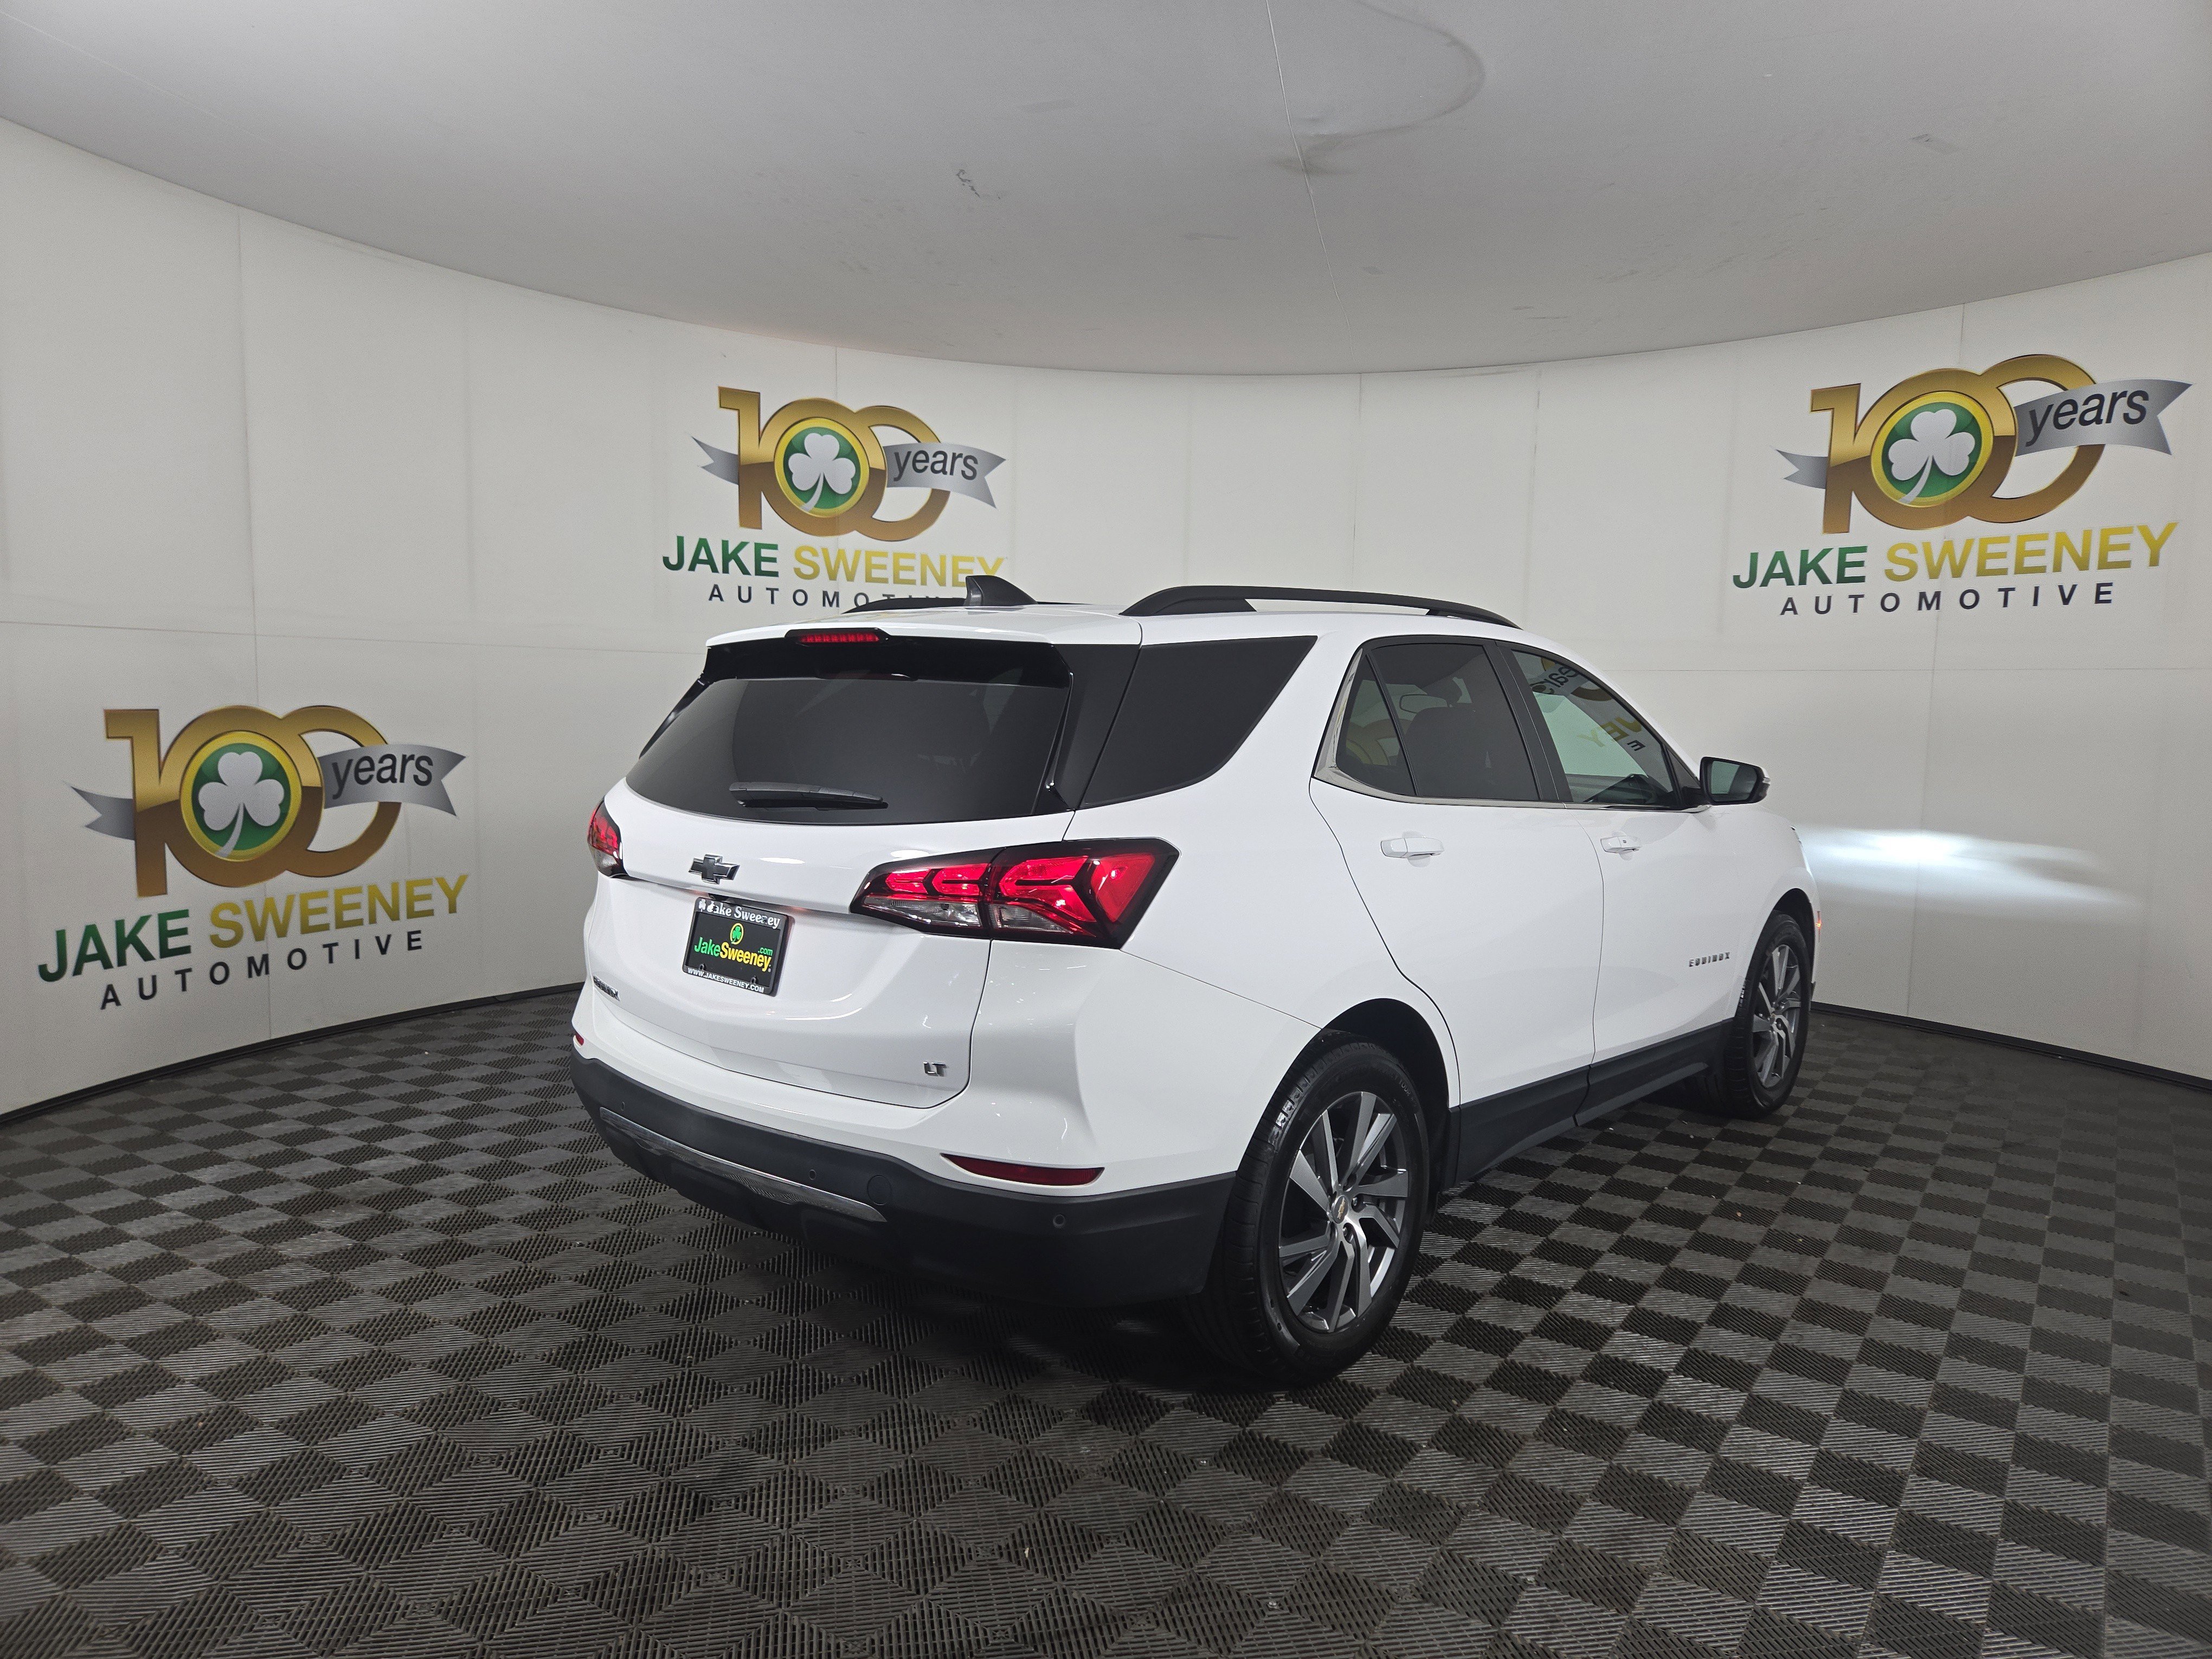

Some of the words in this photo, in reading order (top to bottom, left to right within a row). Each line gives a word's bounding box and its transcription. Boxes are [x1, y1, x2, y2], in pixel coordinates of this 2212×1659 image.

[718, 386, 950, 542] 100
[893, 449, 978, 481] years
[1810, 354, 2105, 535] 100
[2025, 388, 2149, 446] years
[663, 535, 779, 577] JAKE
[1733, 545, 1868, 589] JAKE
[1884, 522, 2178, 582] SWEENEY
[709, 584, 964, 608] AUTOMO
[1780, 582, 2113, 615] AUTOMOTIVE
[104, 705, 402, 897] 100
[331, 751, 434, 799] years
[38, 909, 192, 982] JAKE
[210, 874, 468, 948] SWEENEY
[695, 937, 771, 972] JakeSweeney
[100, 930, 422, 1010] AUTOMOTIVE
[687, 967, 764, 993] WWW.JAKESWEENEY.COM
[923, 1062, 947, 1077] LT
